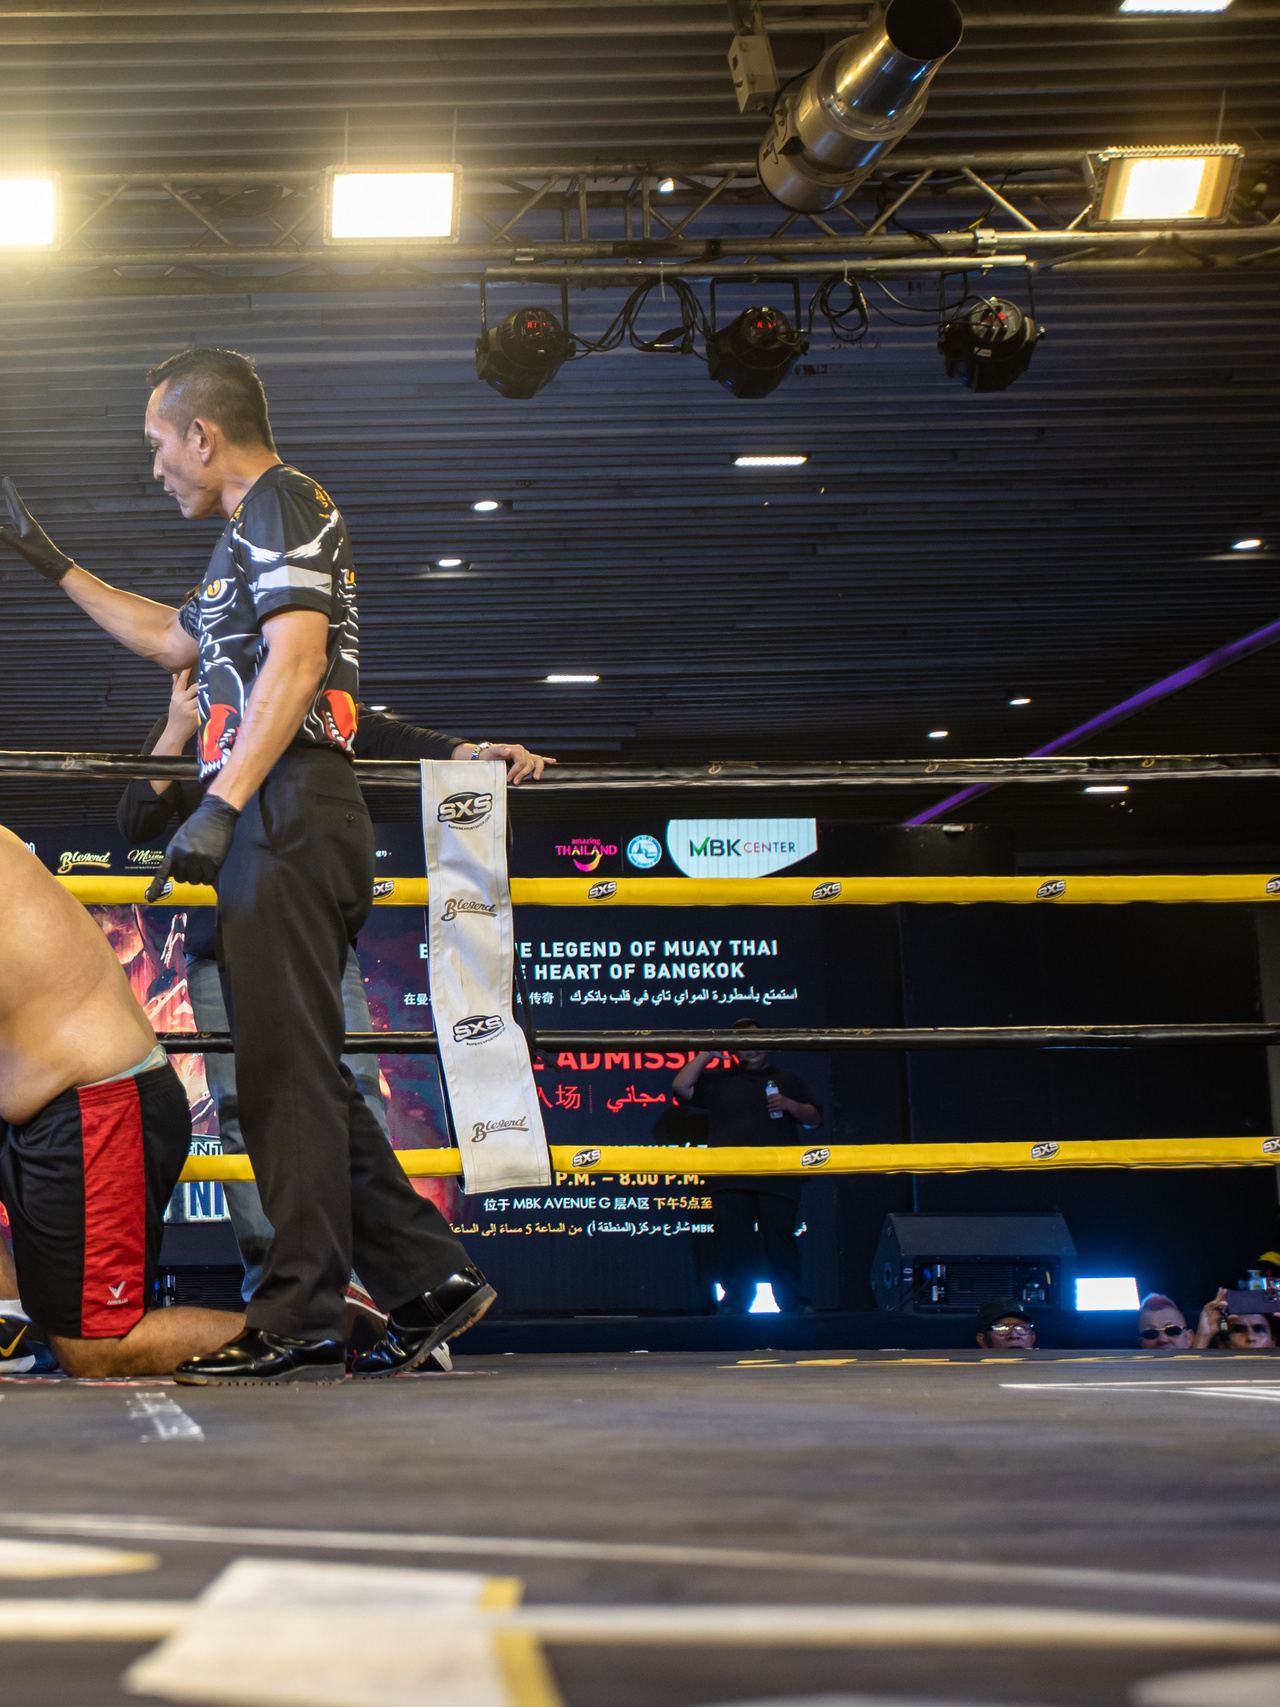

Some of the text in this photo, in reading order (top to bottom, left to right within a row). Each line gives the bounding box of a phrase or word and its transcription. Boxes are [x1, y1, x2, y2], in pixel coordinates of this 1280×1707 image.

[439, 794, 492, 821] SXS
[555, 845, 618, 856] THAILAND
[571, 837, 601, 847] amazing
[689, 837, 796, 857] MBK CENTER
[588, 881, 617, 899] SXS
[812, 882, 841, 900] SXS
[1037, 880, 1066, 899] SXS
[541, 941, 621, 958] LEGEND
[630, 941, 657, 957] OF
[664, 940, 721, 957] MUAY
[730, 939, 778, 957] THAI
[535, 963, 601, 981] HEART
[609, 963, 636, 980] OF
[643, 962, 745, 980] BANGKOK
[453, 1016, 504, 1042] SXS
[572, 1150, 601, 1167] SXS
[801, 1148, 830, 1167] SXS
[1031, 1142, 1060, 1160] SXS
[484, 1198, 510, 1211] 位于
[513, 1198, 541, 1209] MBK
[544, 1197, 596, 1209] AVENUE
[599, 1197, 611, 1209] G
[692, 1224, 714, 1233] MBK
